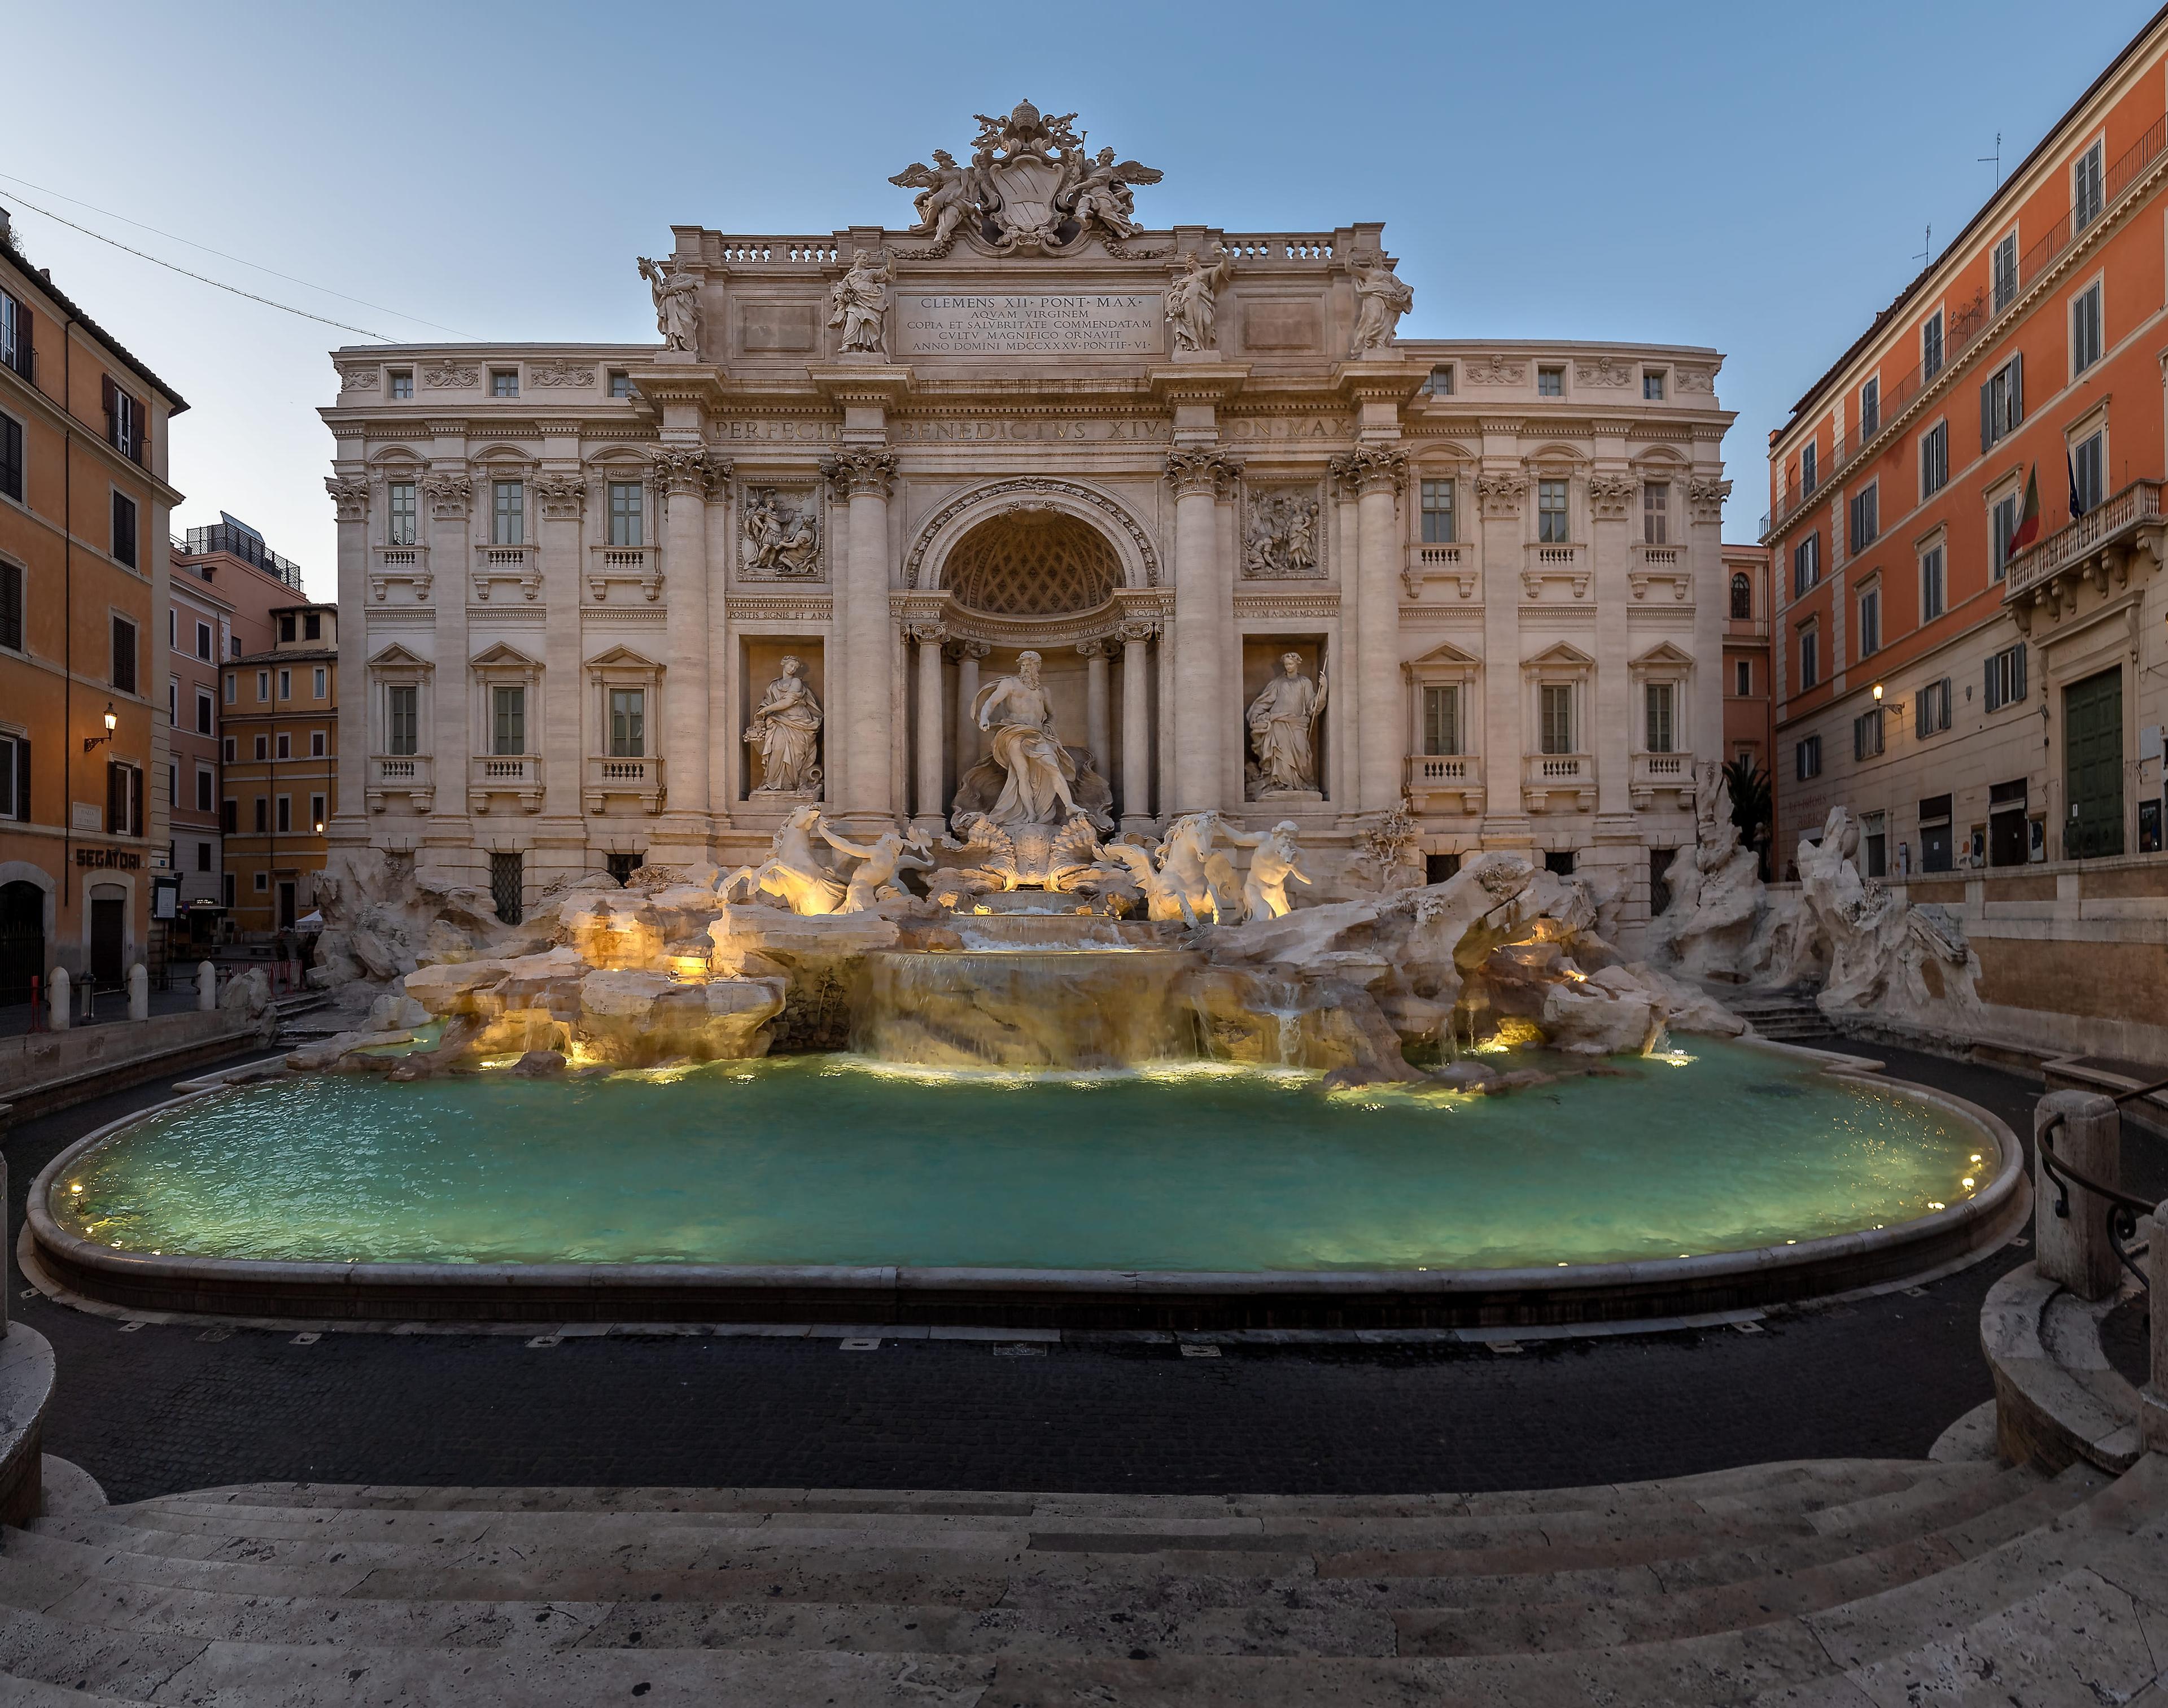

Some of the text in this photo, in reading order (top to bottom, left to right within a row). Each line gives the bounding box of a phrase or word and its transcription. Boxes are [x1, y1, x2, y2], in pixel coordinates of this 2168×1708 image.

[921, 298, 995, 308] CLEMENS
[971, 310, 1089, 321] AQVAM VIRGINEM
[907, 320, 1152, 329] COPIA ET SALVBRITATE COMMENDATAM
[938, 330, 1121, 340] CVLTV MAGNIFICO ORNAVIT
[912, 342, 950, 351] ANNO
[954, 342, 1000, 351] DOMINI
[714, 421, 843, 440] PERFECIT
[901, 421, 1086, 440] BENEDICTVS
[76, 849, 141, 870] SEGATORI
